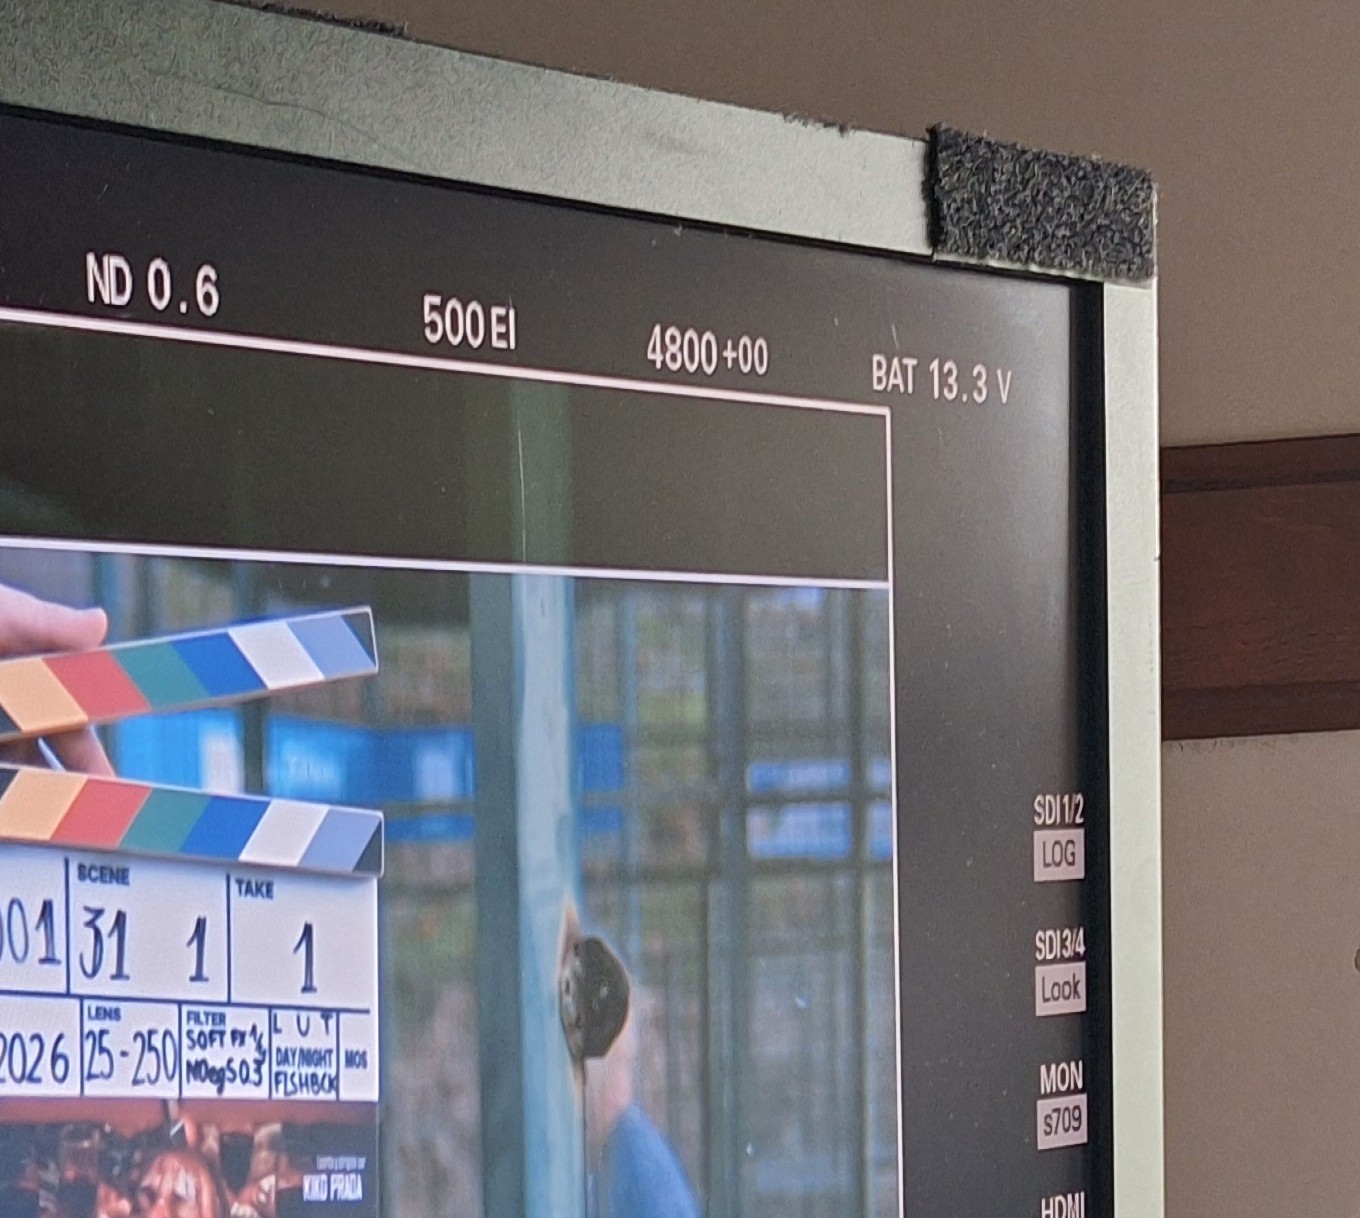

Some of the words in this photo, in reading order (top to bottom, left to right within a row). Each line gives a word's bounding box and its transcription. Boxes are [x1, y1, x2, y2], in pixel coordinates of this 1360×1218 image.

[86, 251, 133, 306] ND
[147, 257, 220, 317] 0.6
[647, 324, 769, 376] 4800+00
[872, 353, 917, 395] BAT
[930, 358, 988, 405] 13.3
[997, 370, 1013, 405] V
[1042, 839, 1076, 868] LOG
[77, 864, 130, 886] SCENE
[235, 878, 274, 899] TAKE
[79, 906, 131, 982] 31
[186, 915, 210, 983] 1
[293, 921, 319, 994] 1
[1042, 973, 1081, 1003] Look
[87, 1006, 122, 1022] LENS
[186, 1010, 227, 1026] FILTER
[186, 1029, 227, 1051] SOFT
[85, 1028, 178, 1087] 25-250
[345, 1049, 368, 1069] MOS
[1040, 1060, 1083, 1095] MON
[1044, 1104, 1082, 1136] s709
